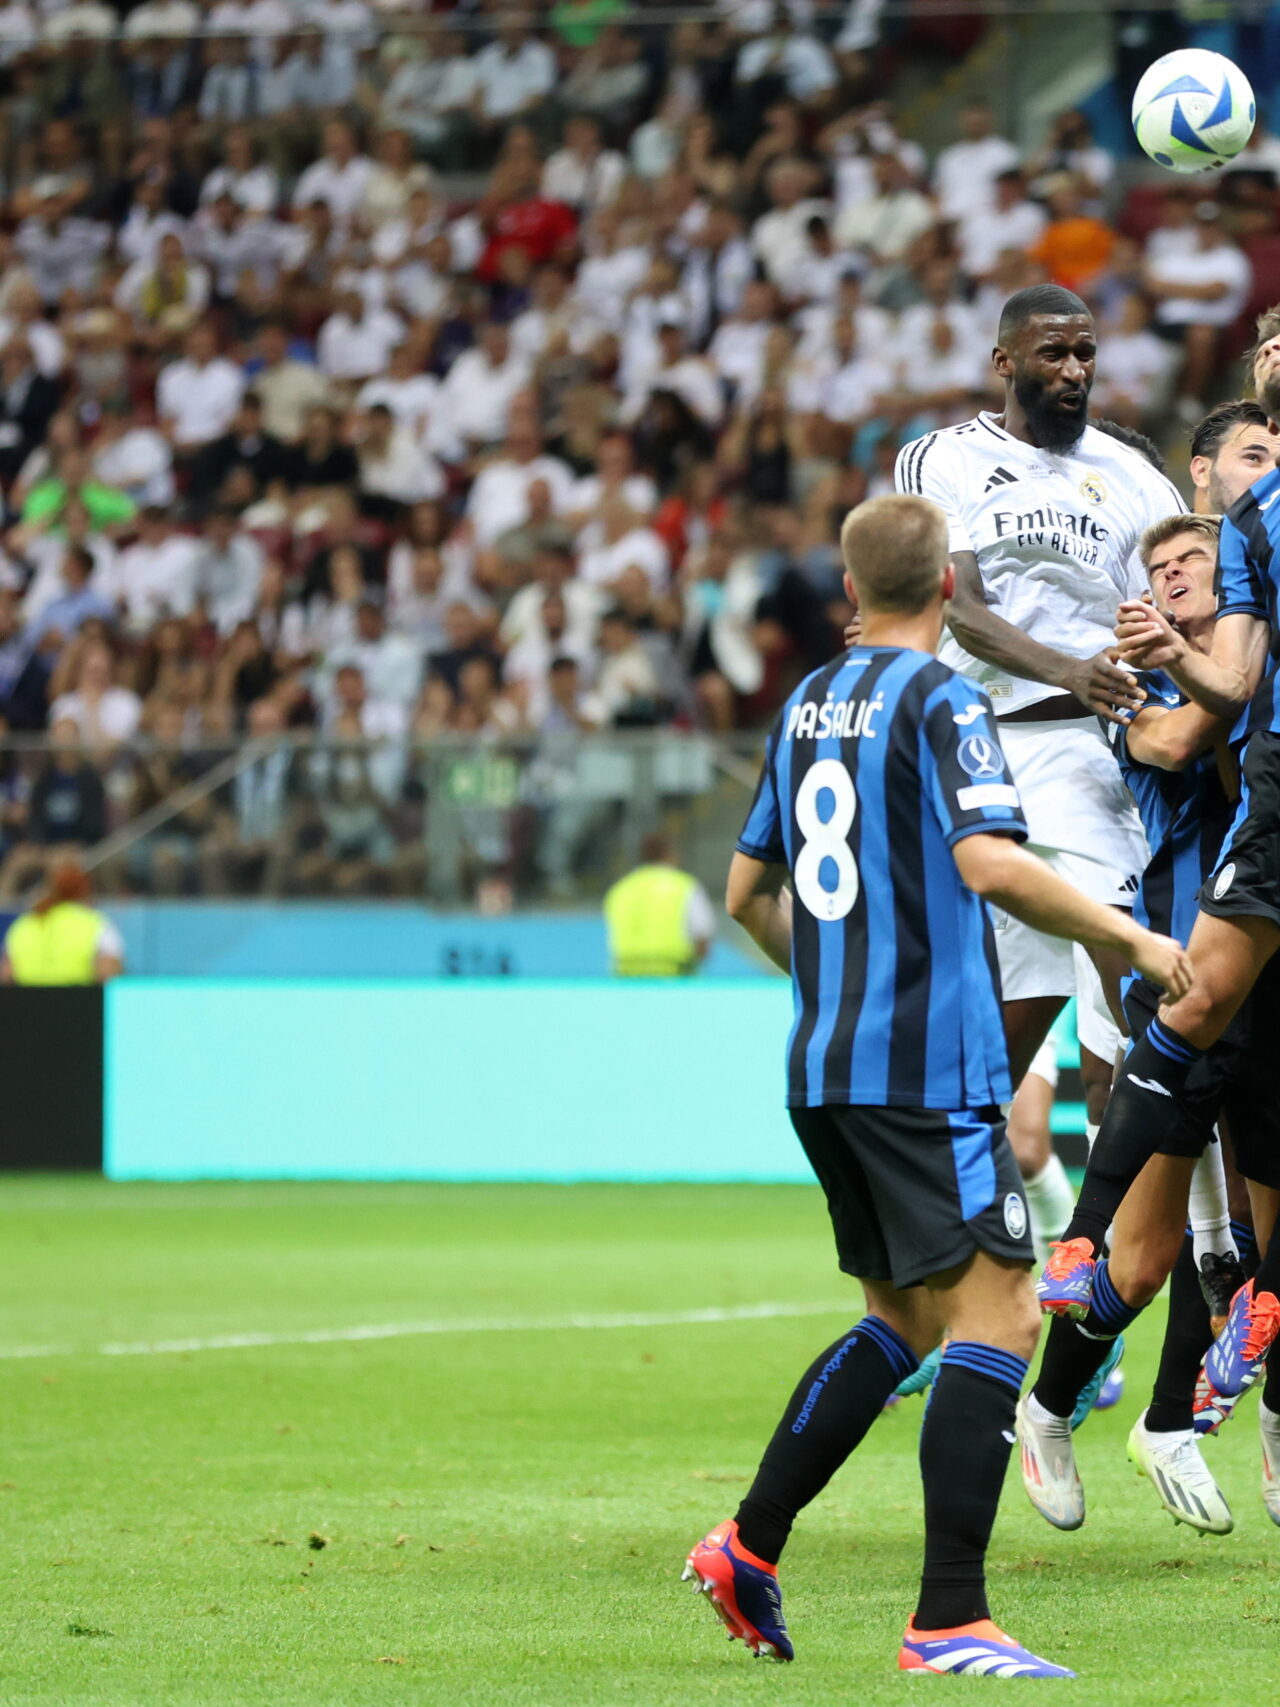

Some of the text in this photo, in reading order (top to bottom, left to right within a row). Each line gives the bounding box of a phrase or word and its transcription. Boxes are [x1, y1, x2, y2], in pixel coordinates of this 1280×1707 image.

[994, 503, 1109, 542] Emirate
[1017, 532, 1098, 566] FLY BETTER
[785, 691, 884, 742] PAŠALIĆ
[794, 758, 859, 922] 8
